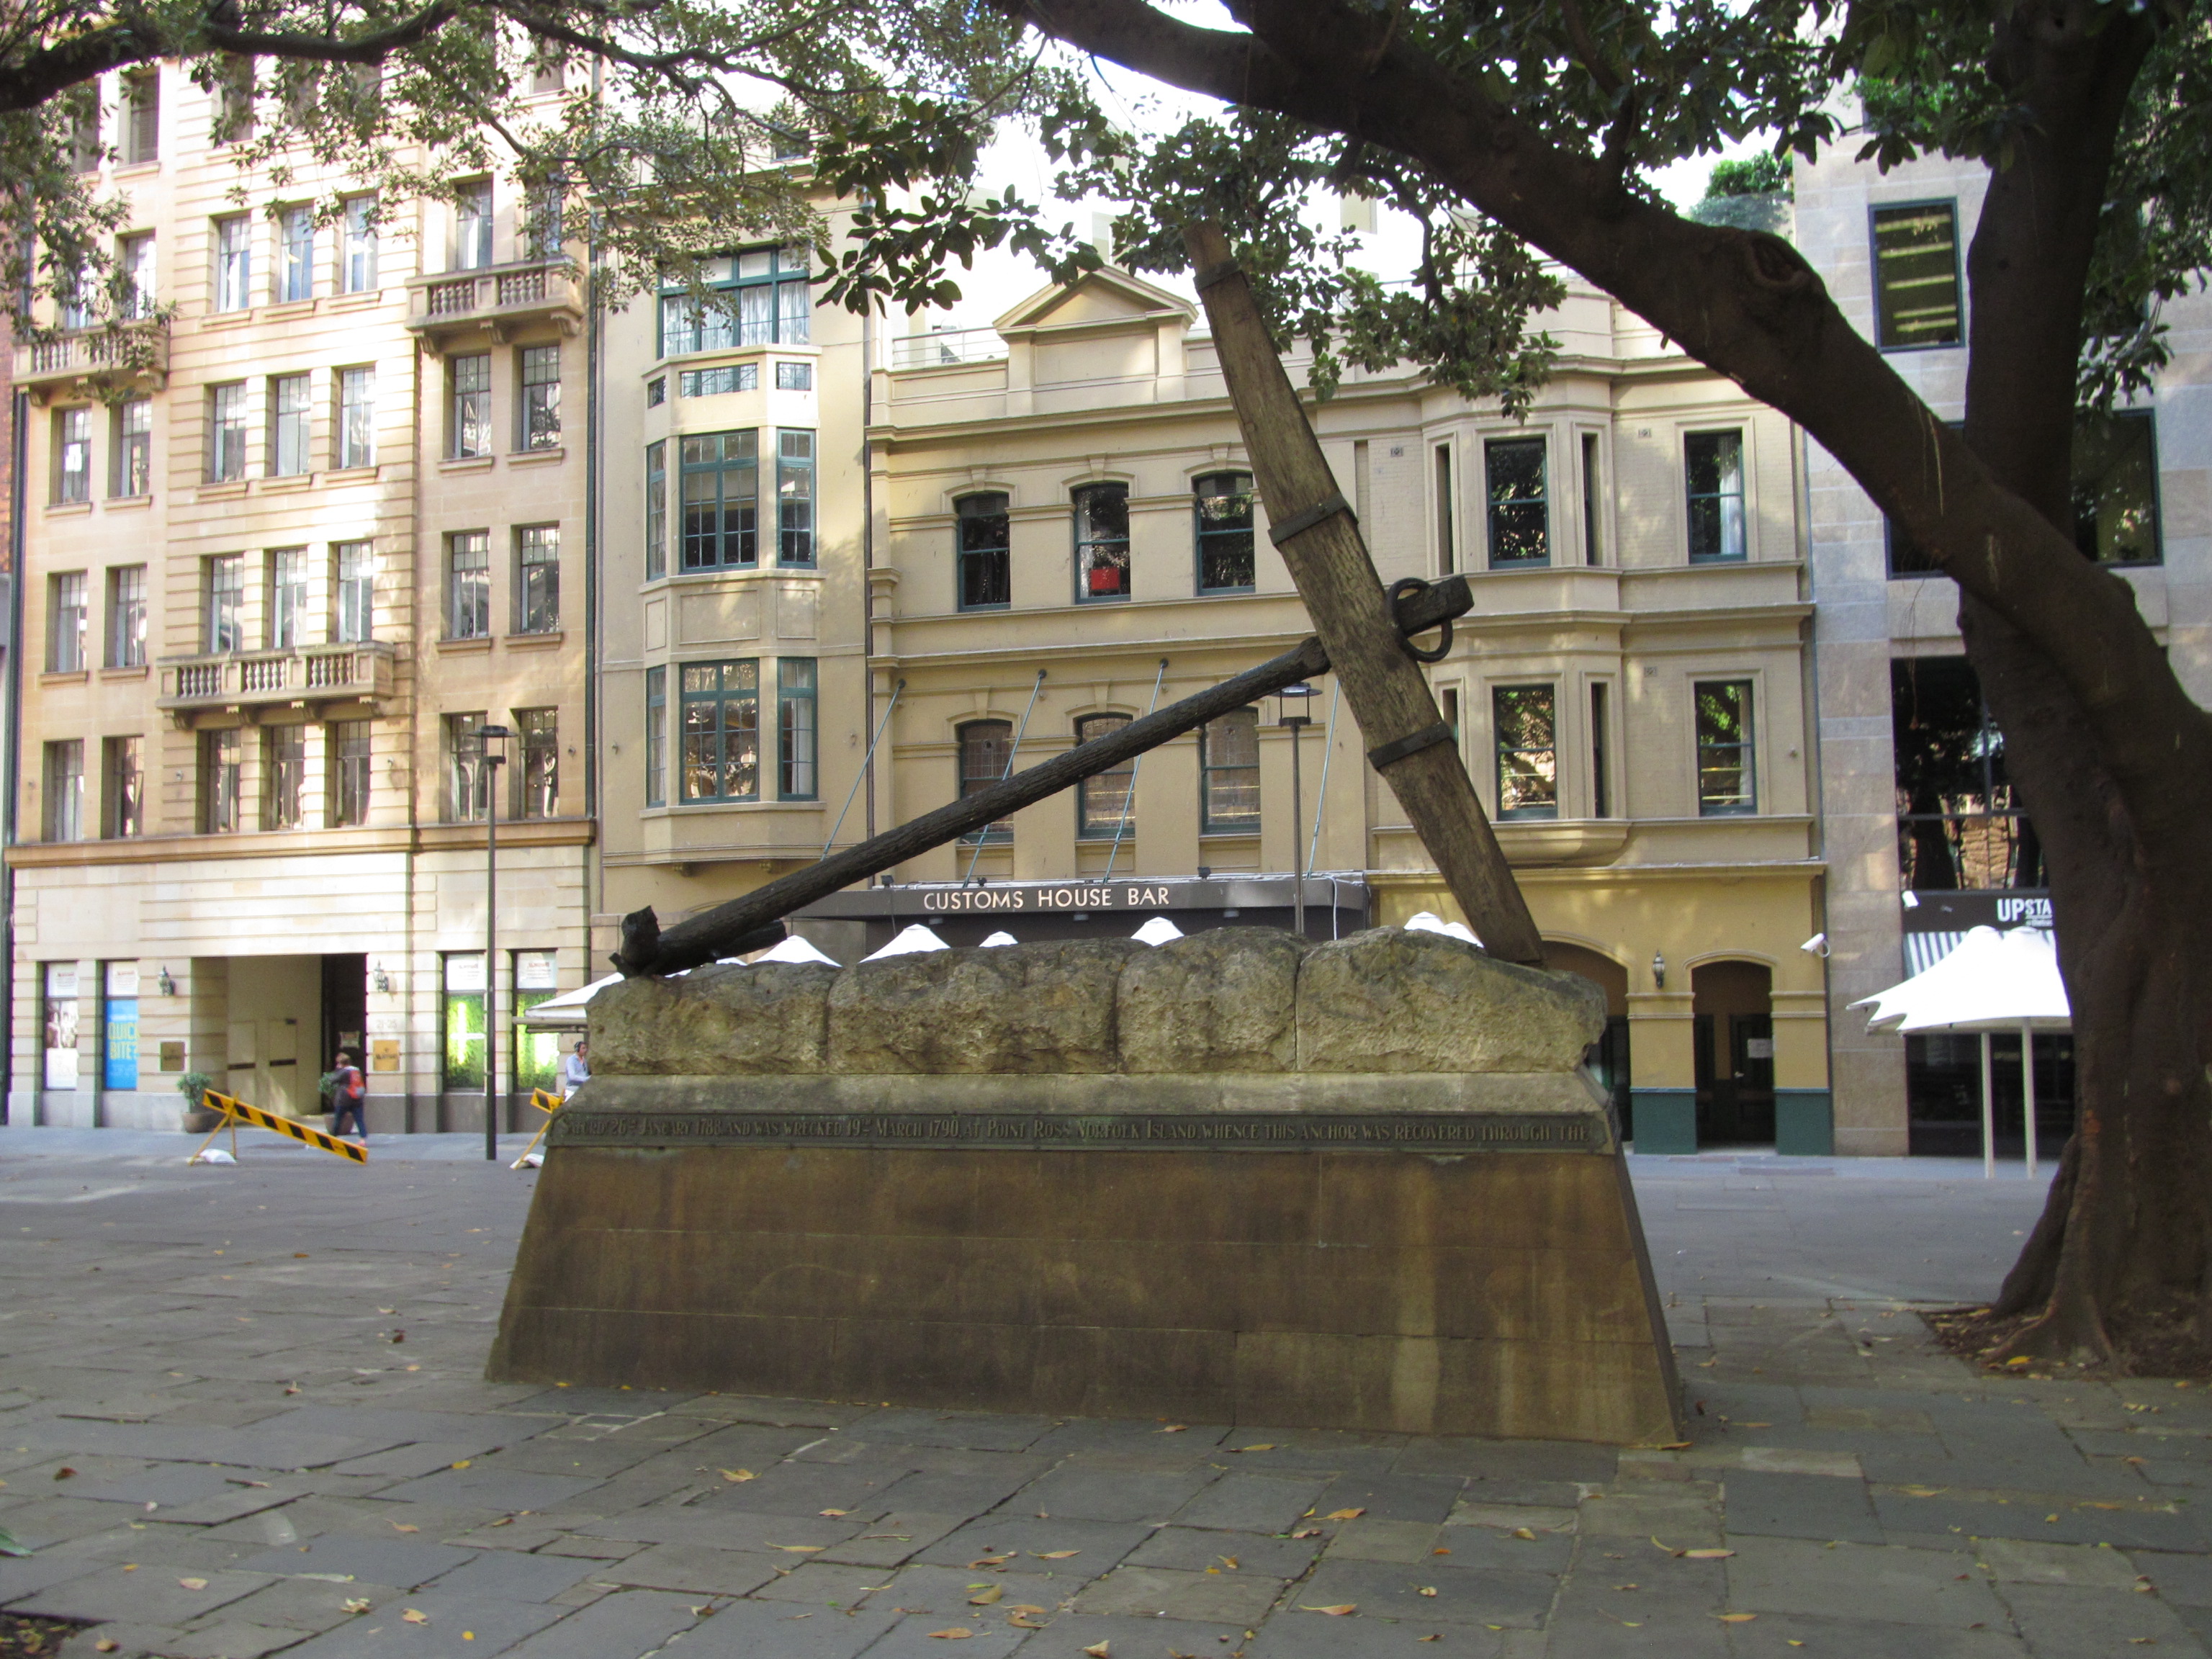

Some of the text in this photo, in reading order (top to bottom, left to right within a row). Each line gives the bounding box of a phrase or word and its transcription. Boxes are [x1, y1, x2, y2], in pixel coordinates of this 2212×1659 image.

[924, 886, 1170, 910] CUSTOMS HOUSE BAR
[727, 1123, 751, 1136] AND
[754, 1123, 778, 1136] WAS
[876, 1118, 922, 1137] MARCH
[964, 1123, 981, 1138] AT
[987, 1120, 1026, 1138] POINT
[1034, 1120, 1071, 1138] ROSS
[1078, 1120, 1140, 1138] NORFOLK
[1202, 1125, 1259, 1140] WHENCE
[1264, 1125, 1295, 1140] THIS
[1300, 1125, 1357, 1140] ANCHOR
[1362, 1125, 1390, 1140] WAS
[1395, 1125, 1475, 1141] RECOVERED
[1480, 1125, 1552, 1141] THROUGH
[1558, 1126, 1591, 1141] THE
